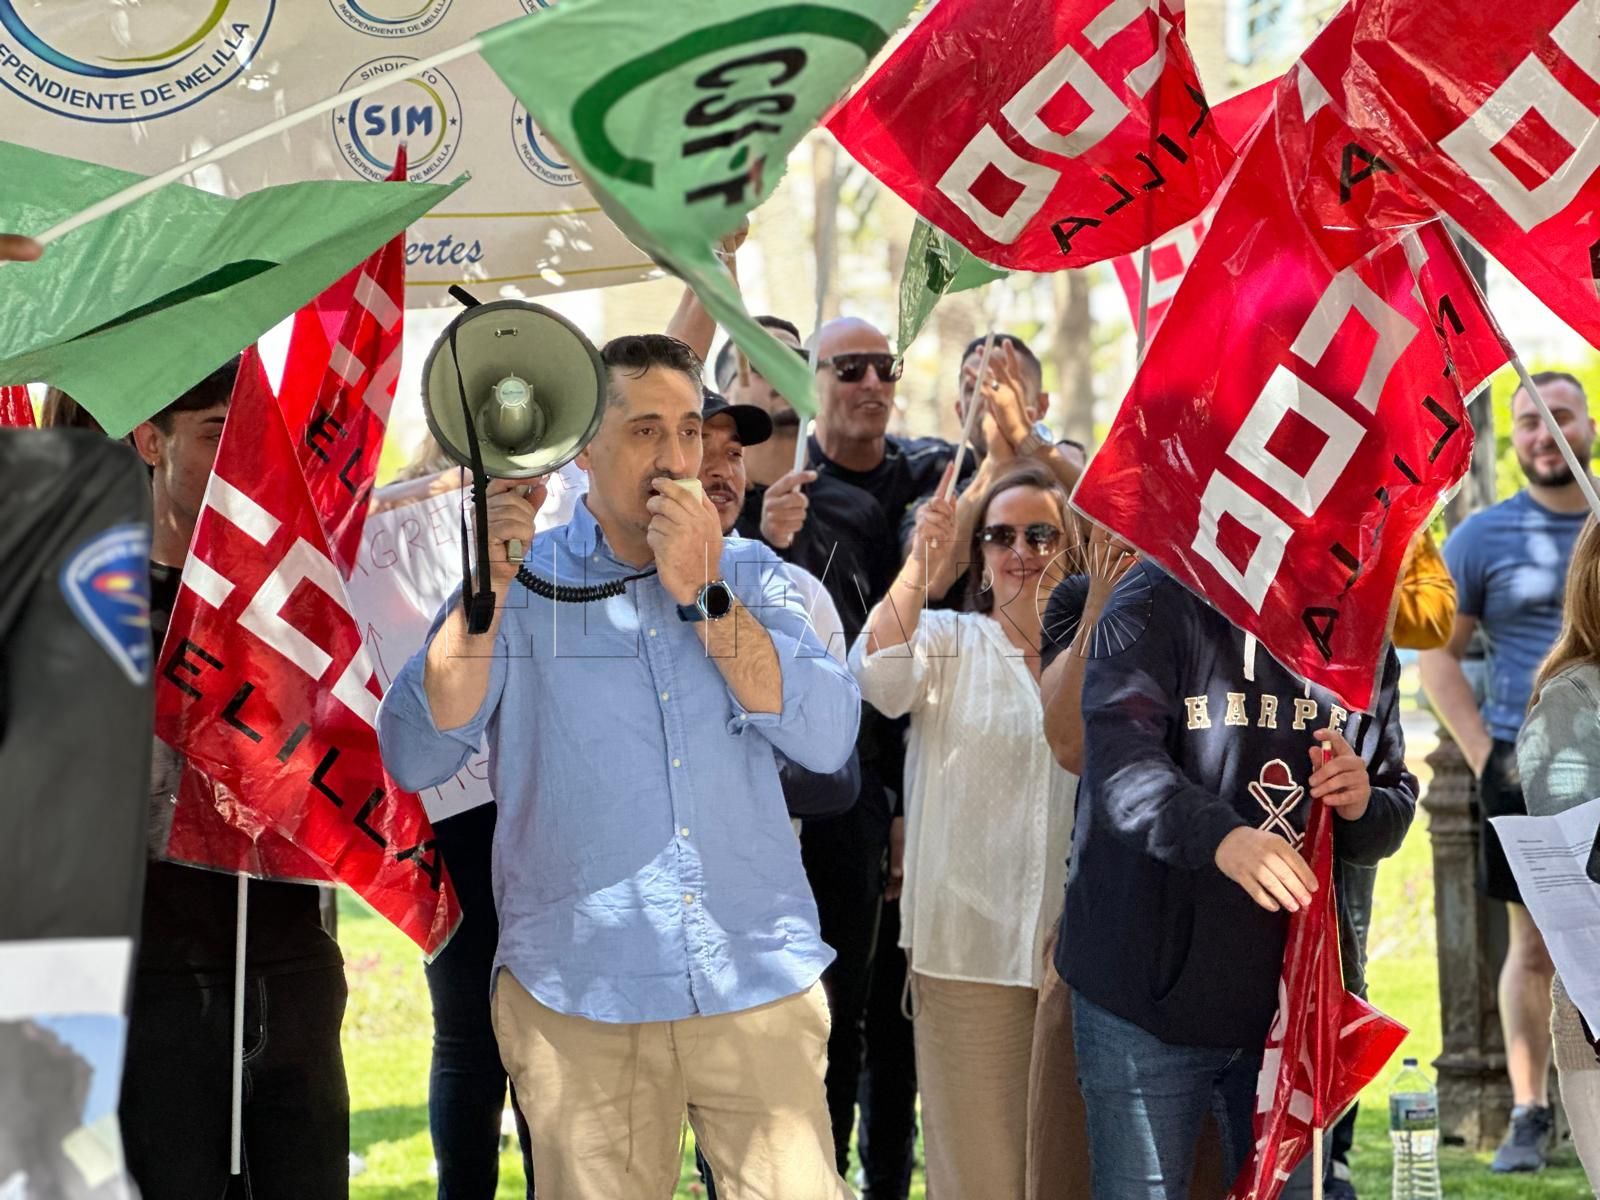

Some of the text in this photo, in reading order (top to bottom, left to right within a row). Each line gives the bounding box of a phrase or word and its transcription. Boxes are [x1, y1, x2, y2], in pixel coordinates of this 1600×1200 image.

[338, 0, 446, 34] INDEPENDIENTE DE MELILL
[141, 83, 176, 106] DE
[176, 21, 249, 92] MELILLA
[360, 62, 438, 85] SINDITO
[363, 105, 432, 136] SIM
[344, 143, 451, 182] INDEPEND DE MELILLA
